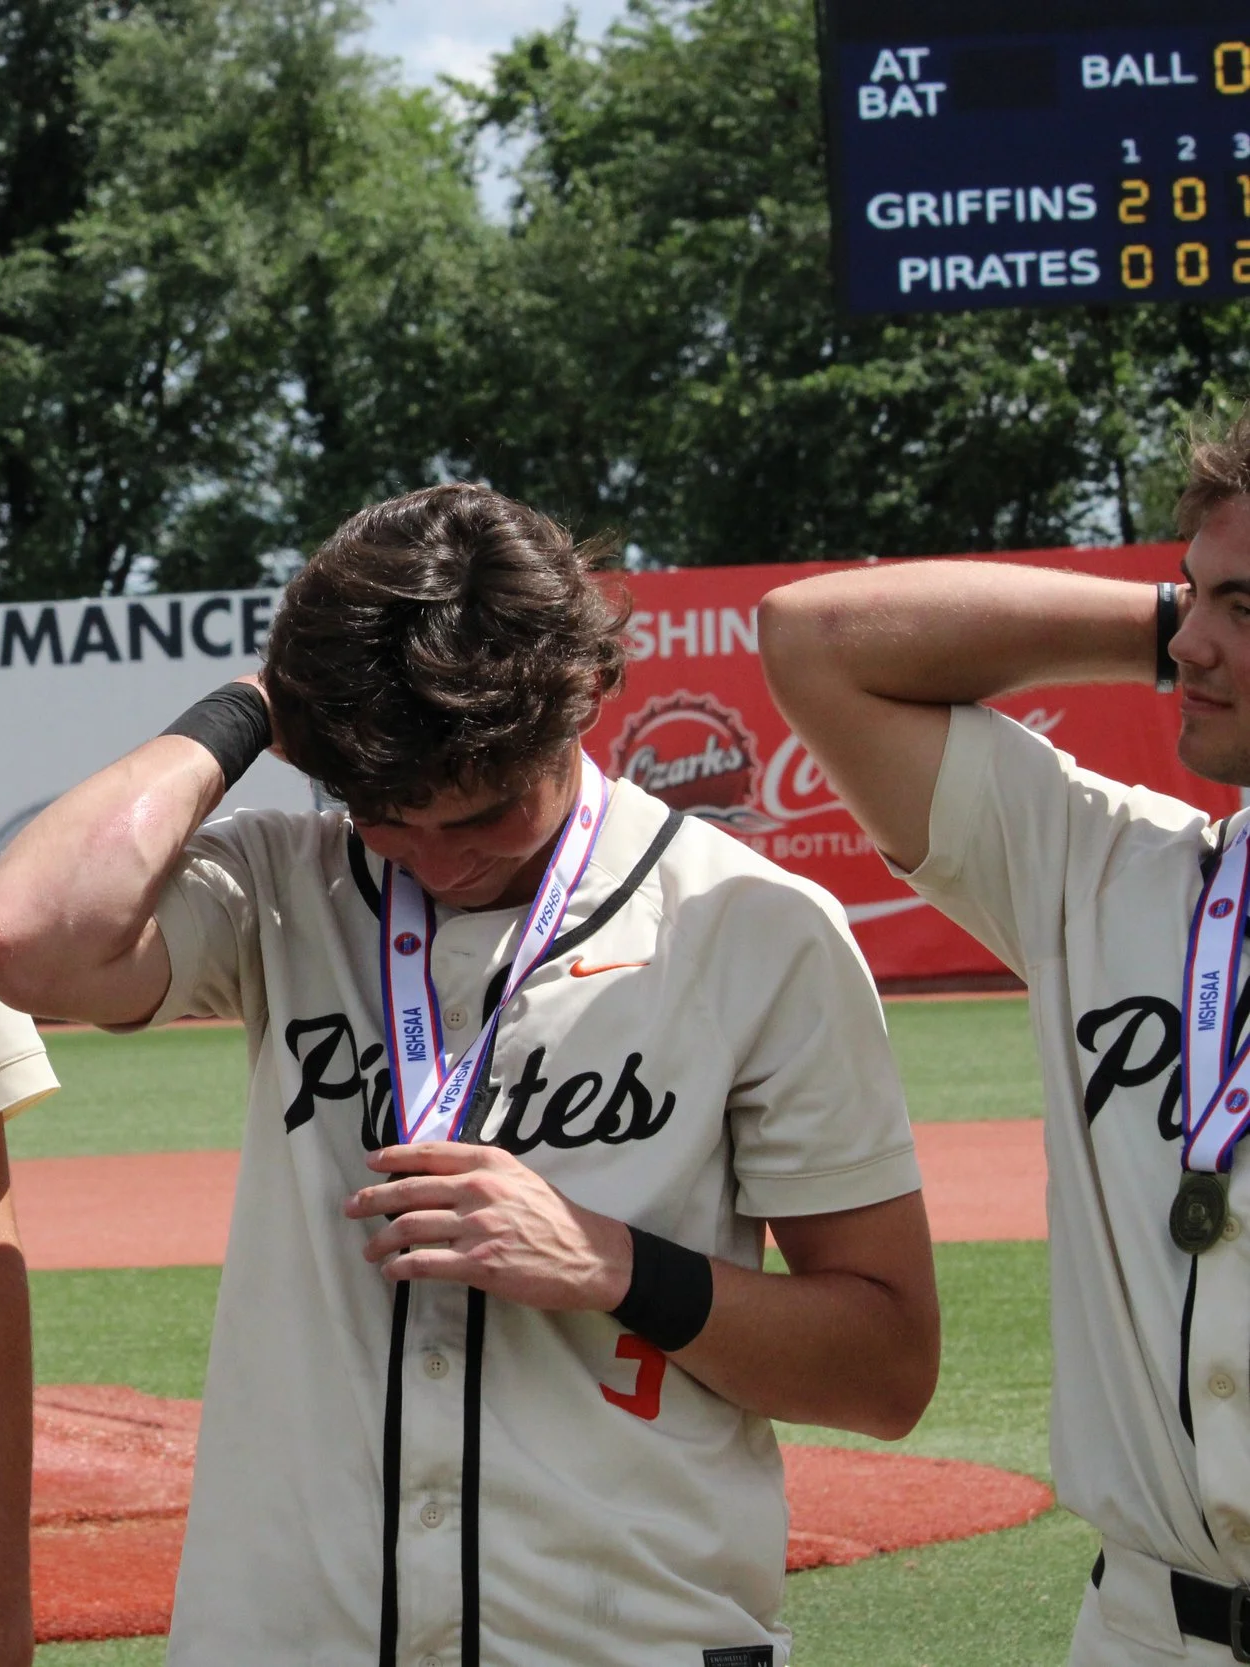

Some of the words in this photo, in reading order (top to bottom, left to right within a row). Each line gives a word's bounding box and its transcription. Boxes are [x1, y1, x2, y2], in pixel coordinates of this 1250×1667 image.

[870, 47, 930, 82] AT
[1081, 52, 1197, 88] BALL
[1214, 41, 1250, 94] 0
[858, 83, 947, 120] BAT
[1121, 138, 1141, 164] 1
[1177, 135, 1197, 161] 2
[1232, 132, 1250, 160] 3
[866, 183, 1098, 230] GRIFFINS
[1119, 179, 1150, 224] 2
[1172, 176, 1207, 222] 0
[899, 248, 1100, 293] PIRATES
[1120, 244, 1153, 289] 0
[1175, 242, 1210, 286] 0
[622, 733, 743, 791] Ozarks
[1198, 970, 1220, 1032] MSHSAA
[403, 1006, 427, 1062] MSHSAA
[284, 1012, 676, 1155] Pites
[438, 1059, 474, 1115] MSHSAA
